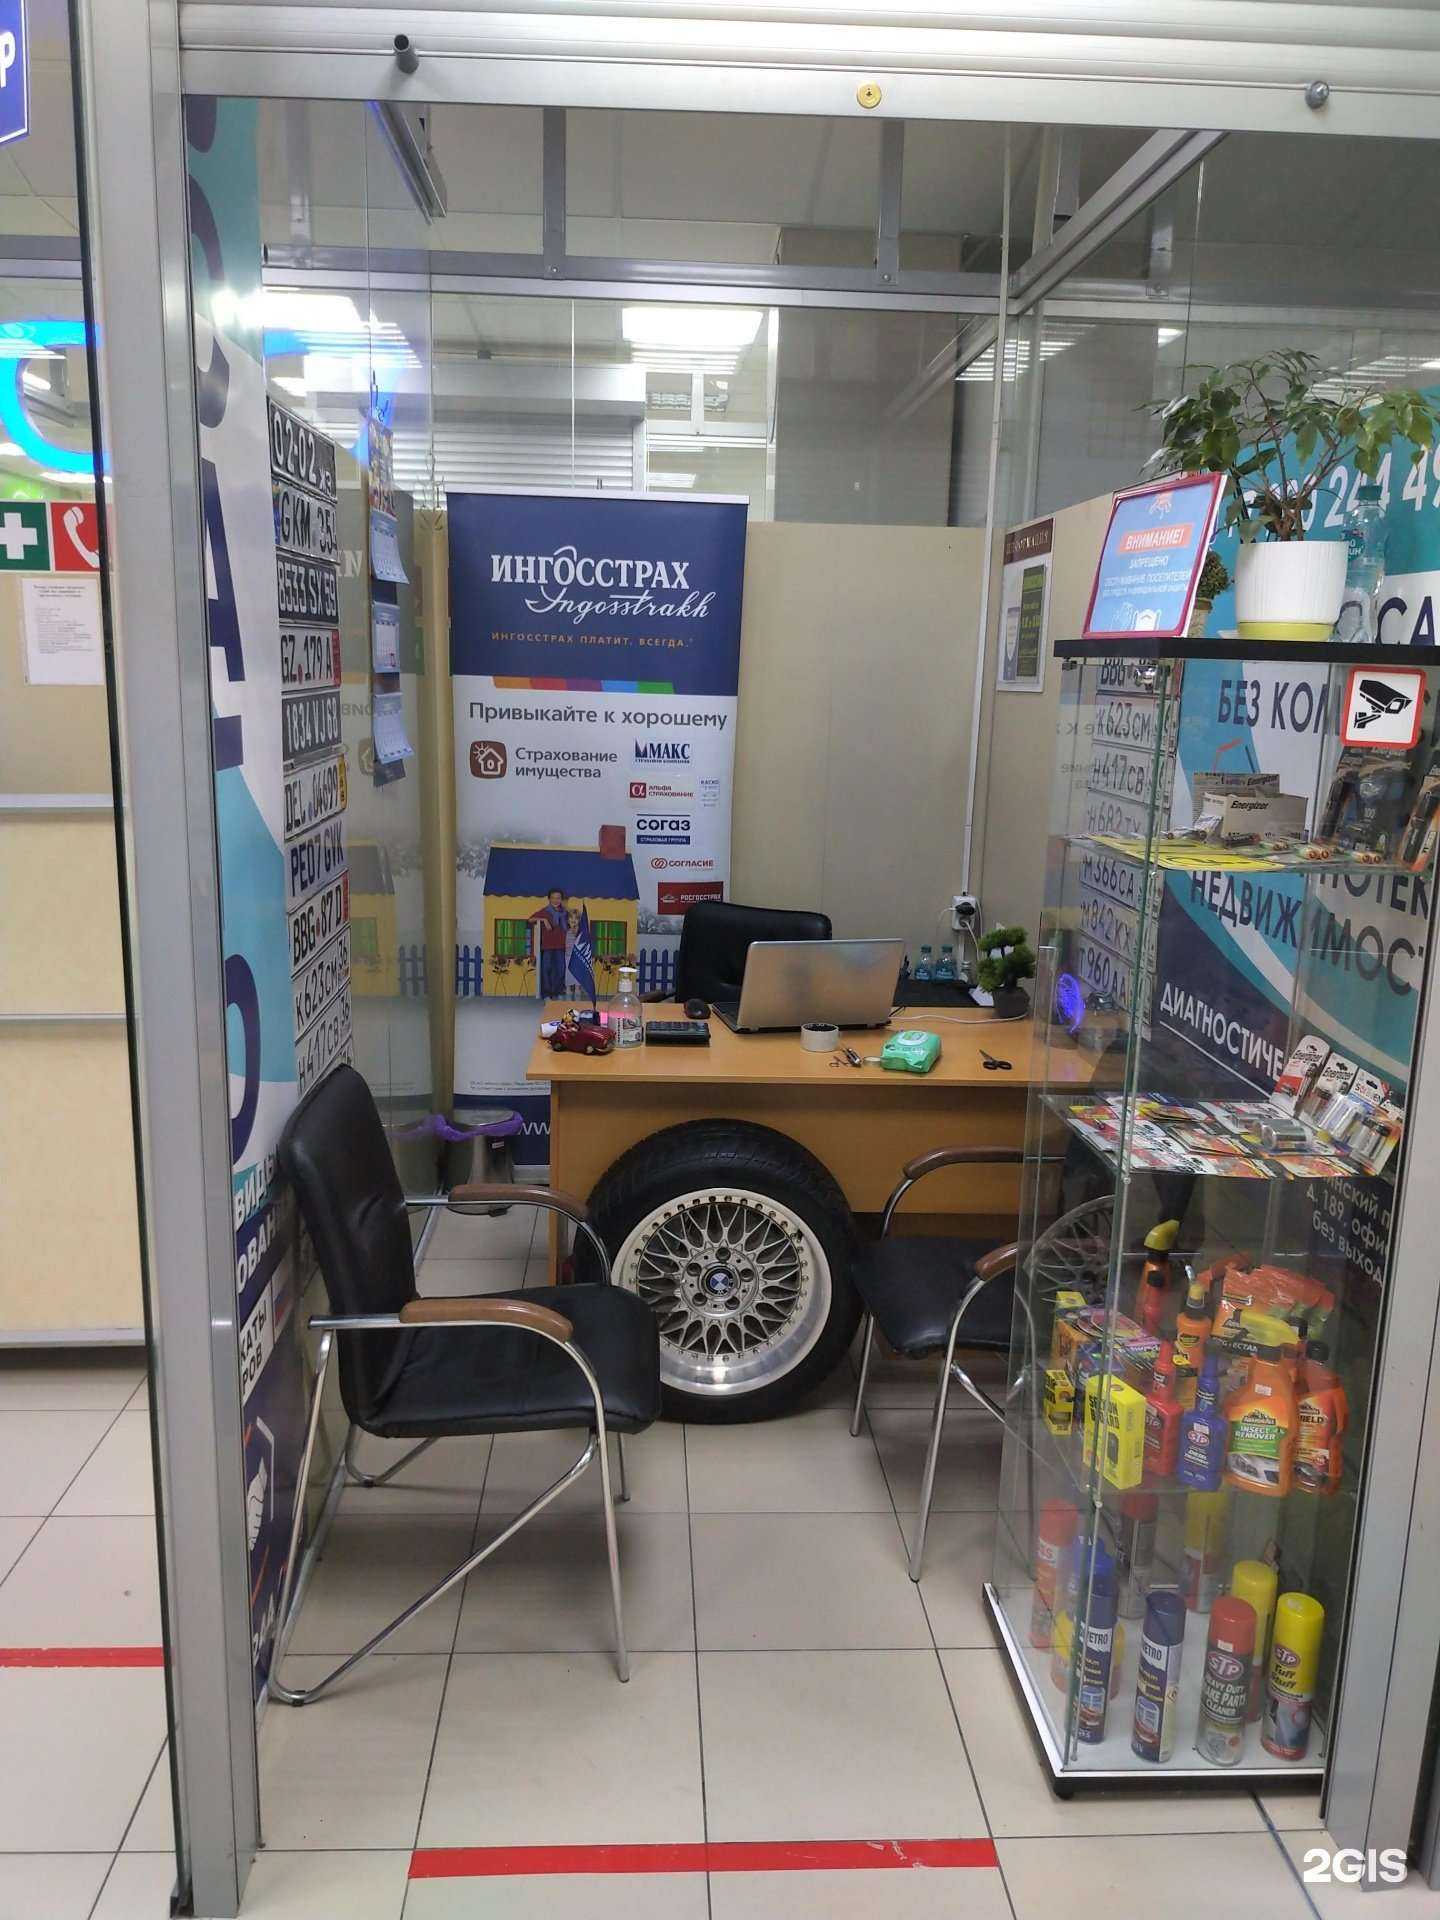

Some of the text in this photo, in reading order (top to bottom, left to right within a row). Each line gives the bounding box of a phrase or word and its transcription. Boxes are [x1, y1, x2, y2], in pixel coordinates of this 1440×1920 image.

[280, 491, 311, 549] GKM
[1125, 528, 1184, 551] ВНИМАНИЕ!
[491, 546, 690, 590] ИНГОССТРАХ
[277, 560, 306, 613] 8533
[308, 565, 323, 616] SX
[524, 586, 717, 625] Ingosstrakh
[491, 632, 573, 644] ИНГОССТРАХ
[469, 702, 728, 731] Привыкайте к хорошему
[1217, 678, 1262, 728] БЕЗ
[515, 747, 618, 764] Страхование
[649, 743, 691, 760] МАКС
[515, 765, 602, 781] имущества
[1230, 800, 1269, 812] Energizer
[668, 859, 714, 867] СОГЛАСИЕ
[680, 893, 721, 901] РОСГОССТРАХ
[293, 905, 316, 967] BBG
[1160, 982, 1284, 1083] ДИАГНОСТИЧЕ
[1312, 1209, 1384, 1288] без выход
[1351, 1218, 1389, 1257] офи
[1234, 1431, 1276, 1441] REMOVER
[1208, 1654, 1241, 1679] STP
